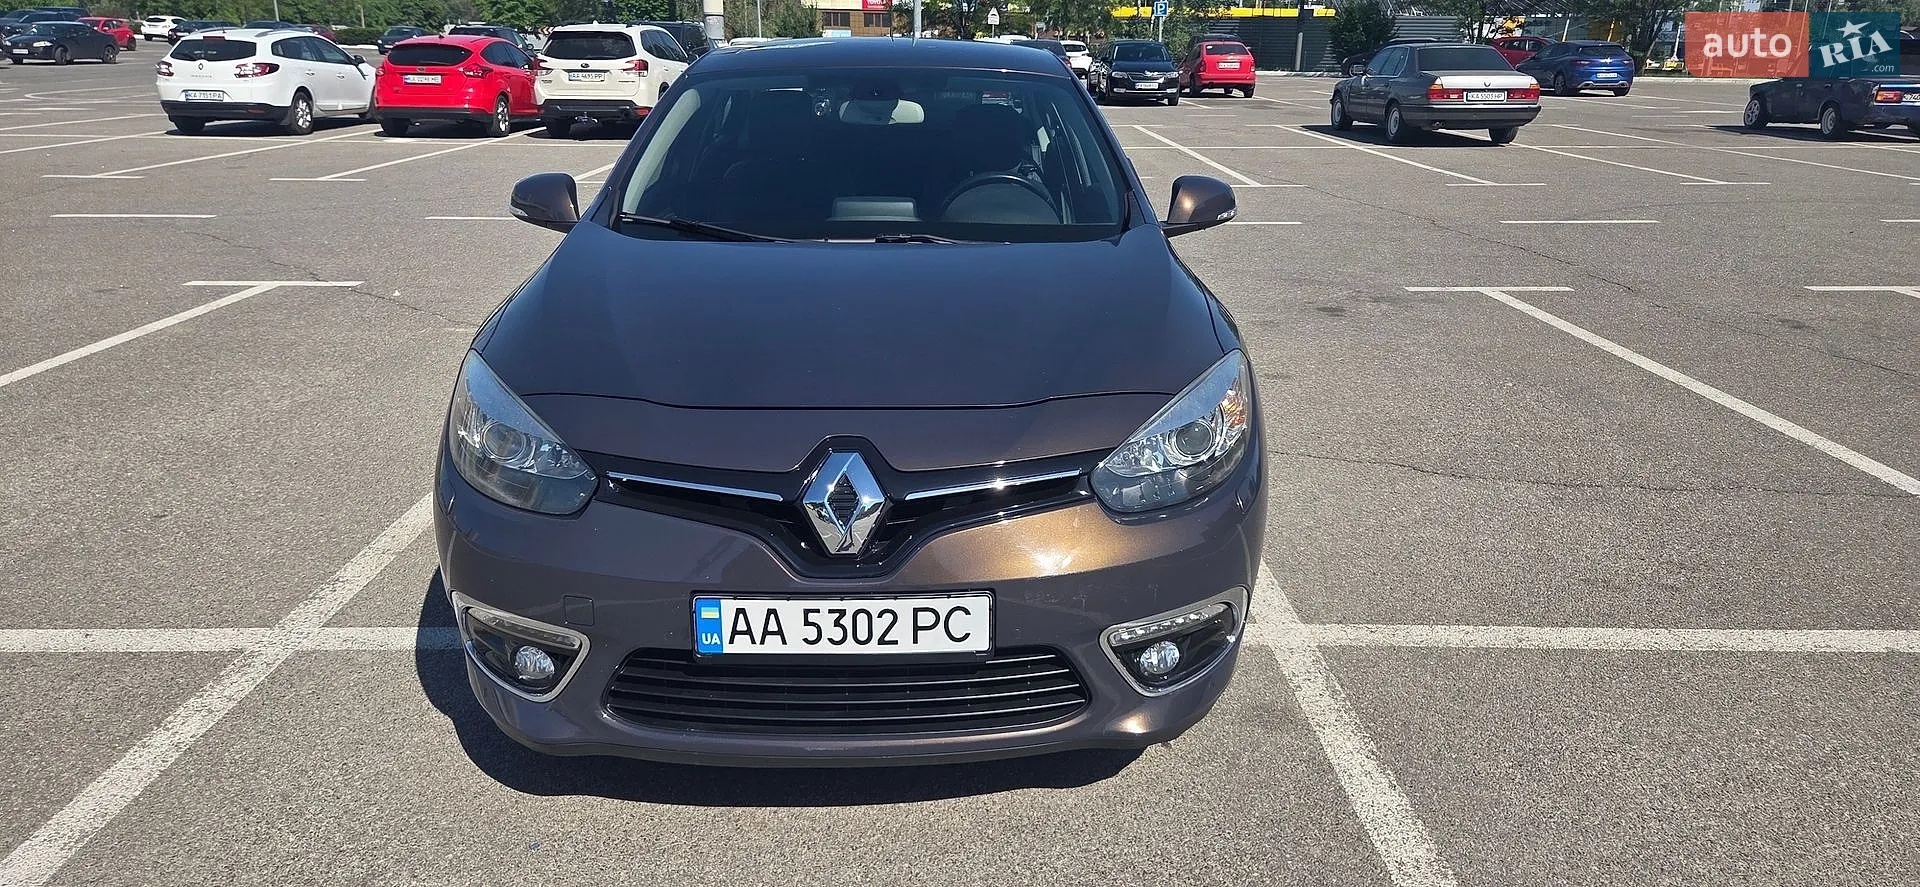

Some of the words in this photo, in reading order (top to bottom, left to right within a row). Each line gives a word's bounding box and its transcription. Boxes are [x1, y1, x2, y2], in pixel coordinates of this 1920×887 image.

[1157, 3, 1166, 14] P
[728, 607, 788, 645] AA
[802, 608, 899, 646] 5302
[911, 605, 972, 645] PC
[701, 633, 721, 645] UA
